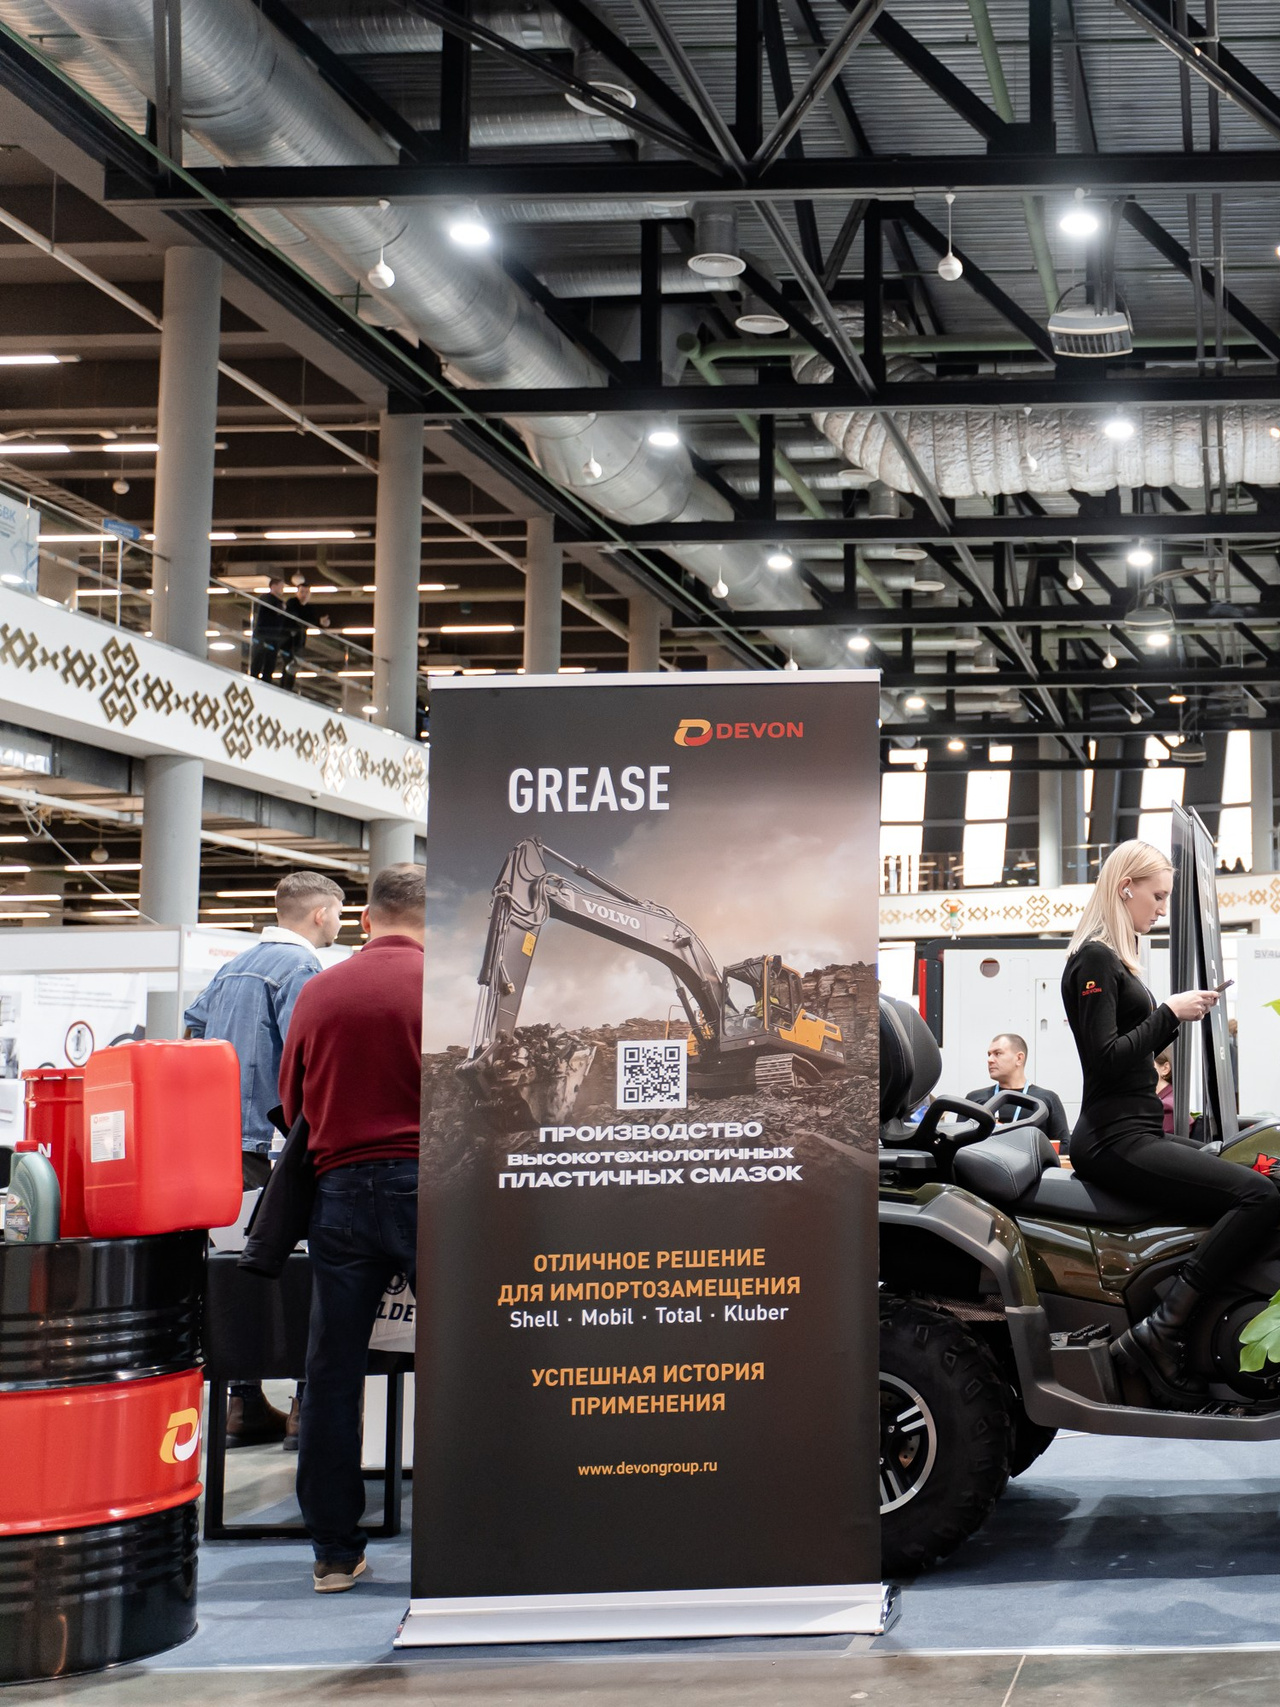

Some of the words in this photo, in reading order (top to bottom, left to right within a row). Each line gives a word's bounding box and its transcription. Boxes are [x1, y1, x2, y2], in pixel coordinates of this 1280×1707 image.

[716, 722, 804, 739] DEVON
[508, 766, 671, 813] GREASE
[582, 899, 641, 929] VOLVO
[539, 1121, 763, 1142] ПРОИЗВОДСТВО
[499, 1168, 685, 1188] ПЛАСТИЧНЫХ
[690, 1165, 803, 1183] СМАЗОК
[534, 1252, 650, 1272] ОТЛИЧНОЕ
[656, 1248, 766, 1269] РЕШЕНИЕ
[497, 1284, 544, 1306] ДЛЯ
[550, 1276, 801, 1301] ИМПОРТОЗАМЕЩЕНИЯ
[510, 1310, 559, 1328] Shell
[581, 1307, 634, 1326] Mobil
[655, 1306, 702, 1324] Total
[724, 1304, 789, 1322] Kluber
[531, 1366, 656, 1387] УСПЕШНАЯ
[663, 1362, 765, 1383] ИСТОРИЯ
[571, 1393, 725, 1416] ПРИМЕНЕНИЯ
[578, 1461, 718, 1477] www.devongroup.ru
